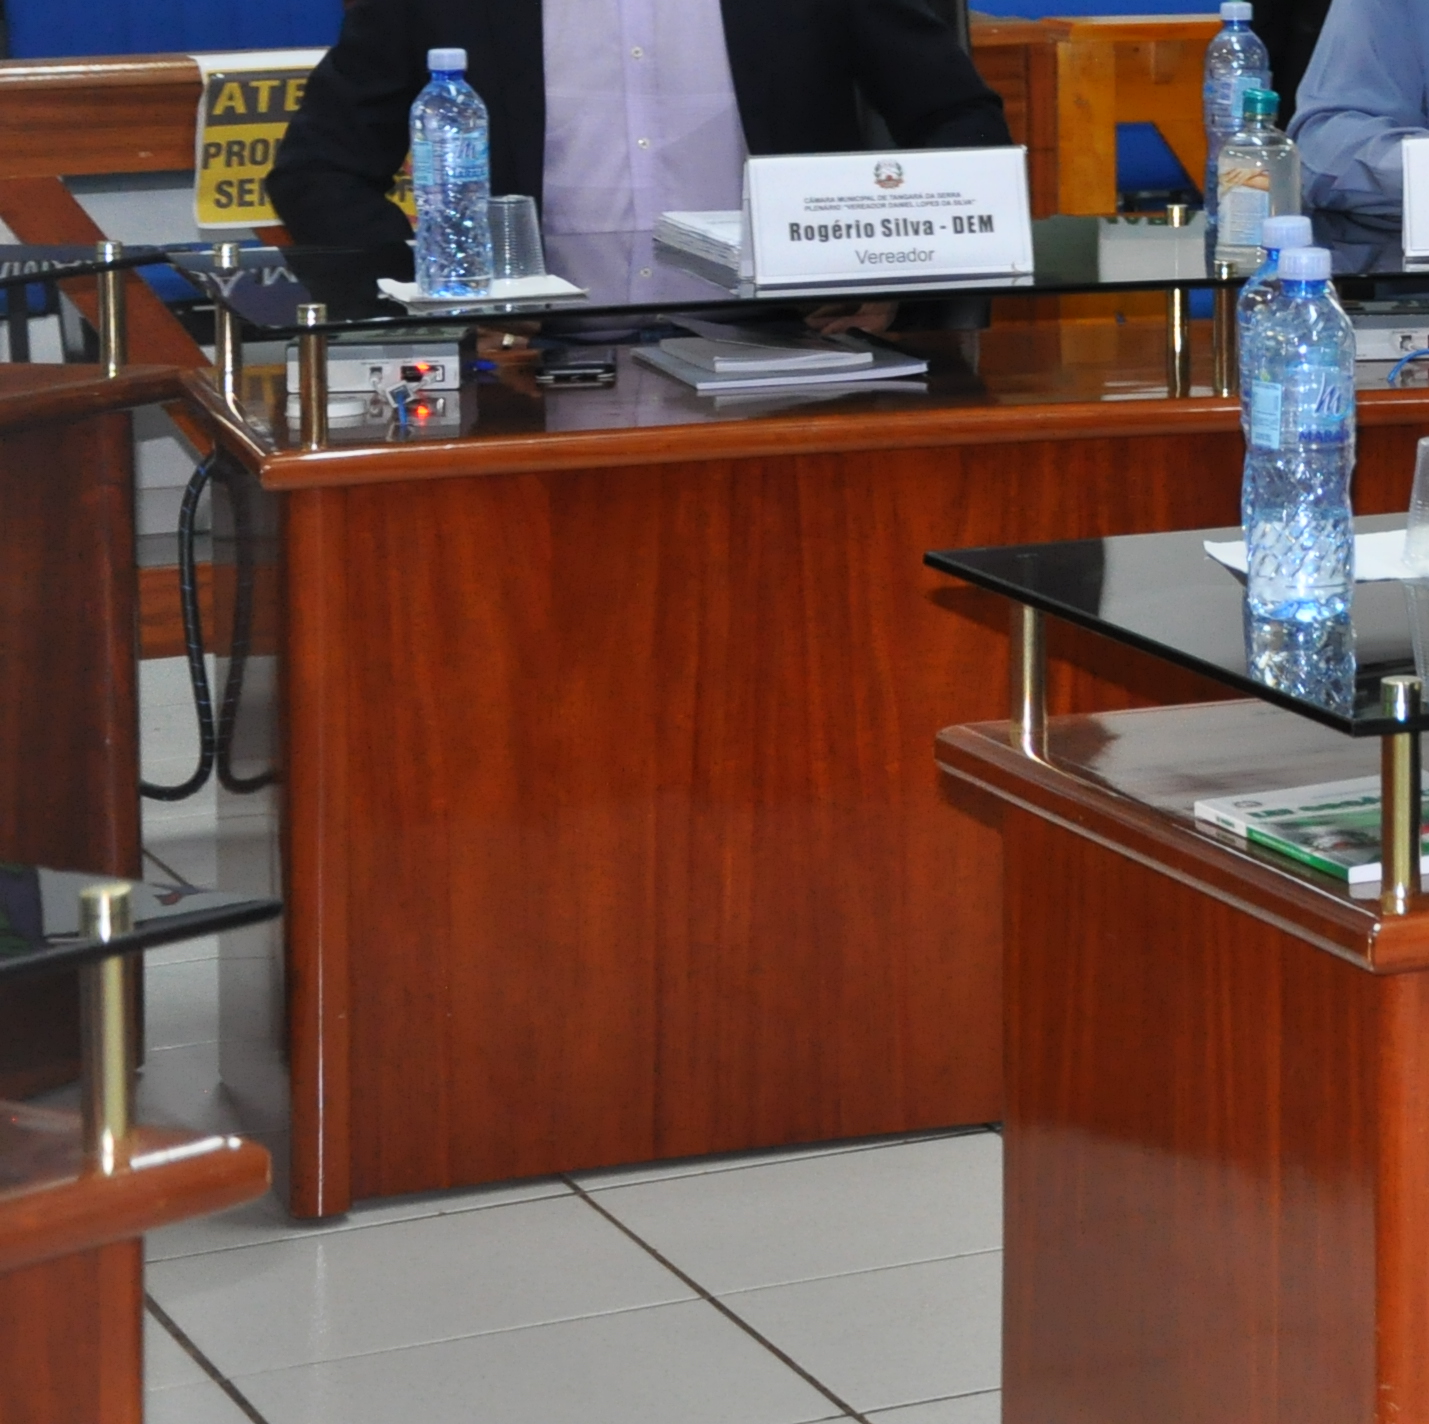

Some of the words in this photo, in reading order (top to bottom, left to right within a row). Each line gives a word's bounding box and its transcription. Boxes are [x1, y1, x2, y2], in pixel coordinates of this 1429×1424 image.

[202, 138, 283, 170] PRO
[789, 219, 875, 242] Rogério
[881, 218, 935, 238] Silva
[952, 214, 995, 235] DEM
[855, 248, 935, 265] Vereador
